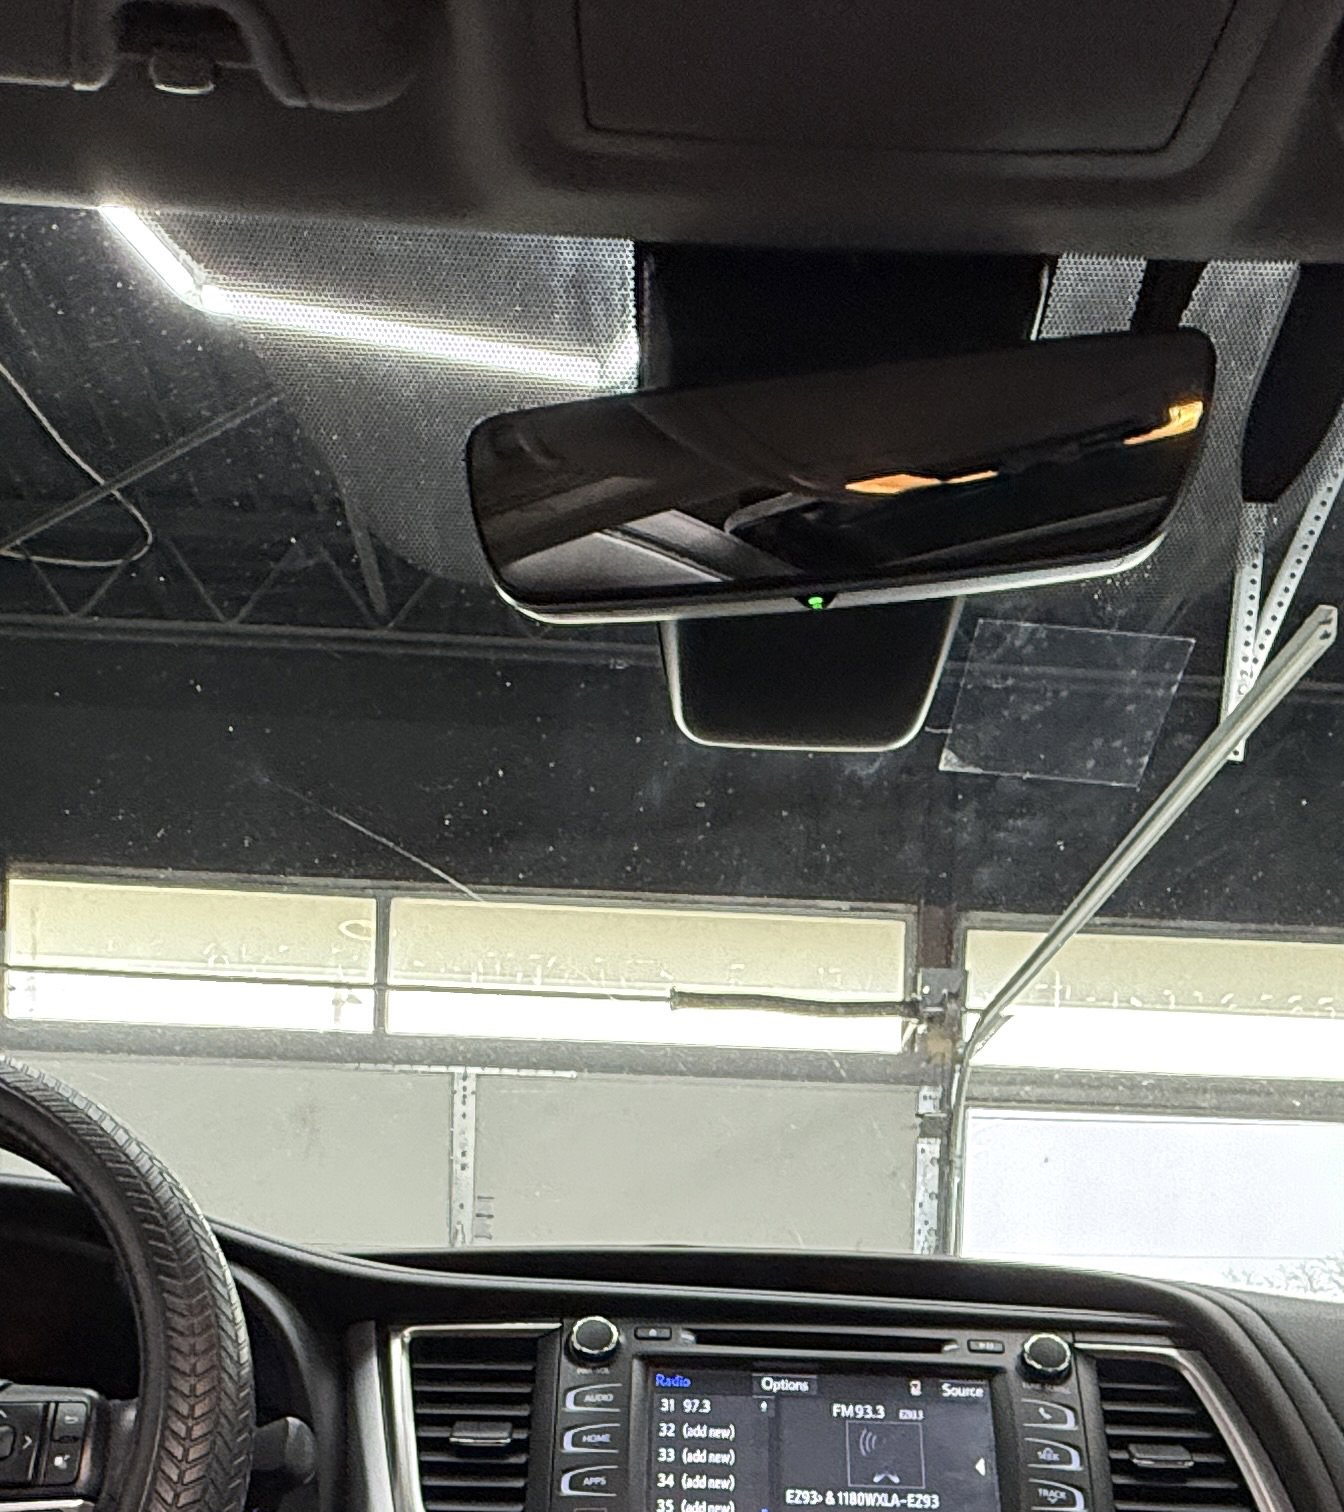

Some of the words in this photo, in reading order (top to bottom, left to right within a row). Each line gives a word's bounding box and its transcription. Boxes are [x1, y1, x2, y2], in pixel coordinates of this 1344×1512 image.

[656, 1374, 691, 1388] Radio
[761, 1376, 809, 1393] Options
[584, 1393, 613, 1402] AUDIO
[941, 1382, 984, 1398] Source
[661, 1399, 675, 1413] 31
[683, 1400, 711, 1413] 97.3
[582, 1433, 611, 1443] HOME
[659, 1423, 676, 1438] 32
[683, 1424, 707, 1439] (add
[708, 1424, 735, 1440] new)
[658, 1448, 675, 1462] 33
[682, 1448, 707, 1465] (add
[708, 1449, 736, 1466] new)
[583, 1475, 607, 1486] APPS
[657, 1473, 674, 1488] 34
[681, 1473, 707, 1490] (add
[708, 1475, 736, 1492] new)
[825, 1490, 836, 1506] &
[1038, 1488, 1067, 1500] TRACK
